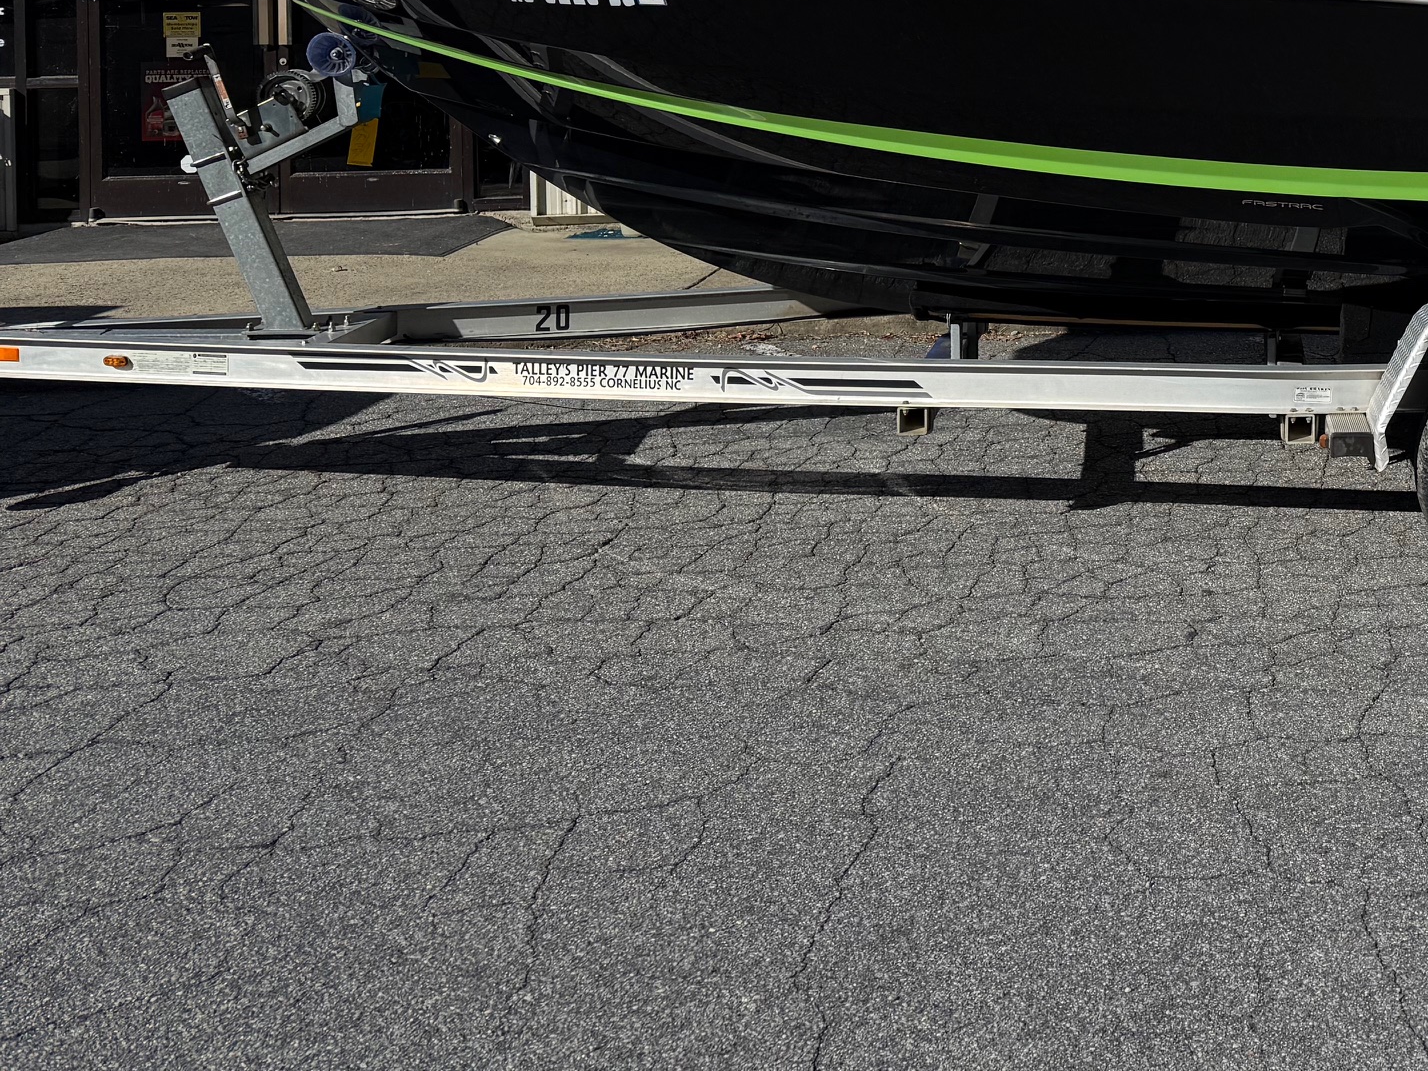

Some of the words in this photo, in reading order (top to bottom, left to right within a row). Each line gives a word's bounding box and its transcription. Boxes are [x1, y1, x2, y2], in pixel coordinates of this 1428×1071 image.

[1241, 199, 1324, 211] FASTRAC
[535, 304, 570, 332] 20
[512, 362, 572, 376] TALLEY'S
[576, 363, 608, 378] PIER
[613, 364, 630, 378] 77
[634, 365, 694, 381] MARINE
[522, 375, 596, 388] 704-892-8555
[599, 377, 662, 390] CORNELIUS
[665, 379, 682, 391] NC
